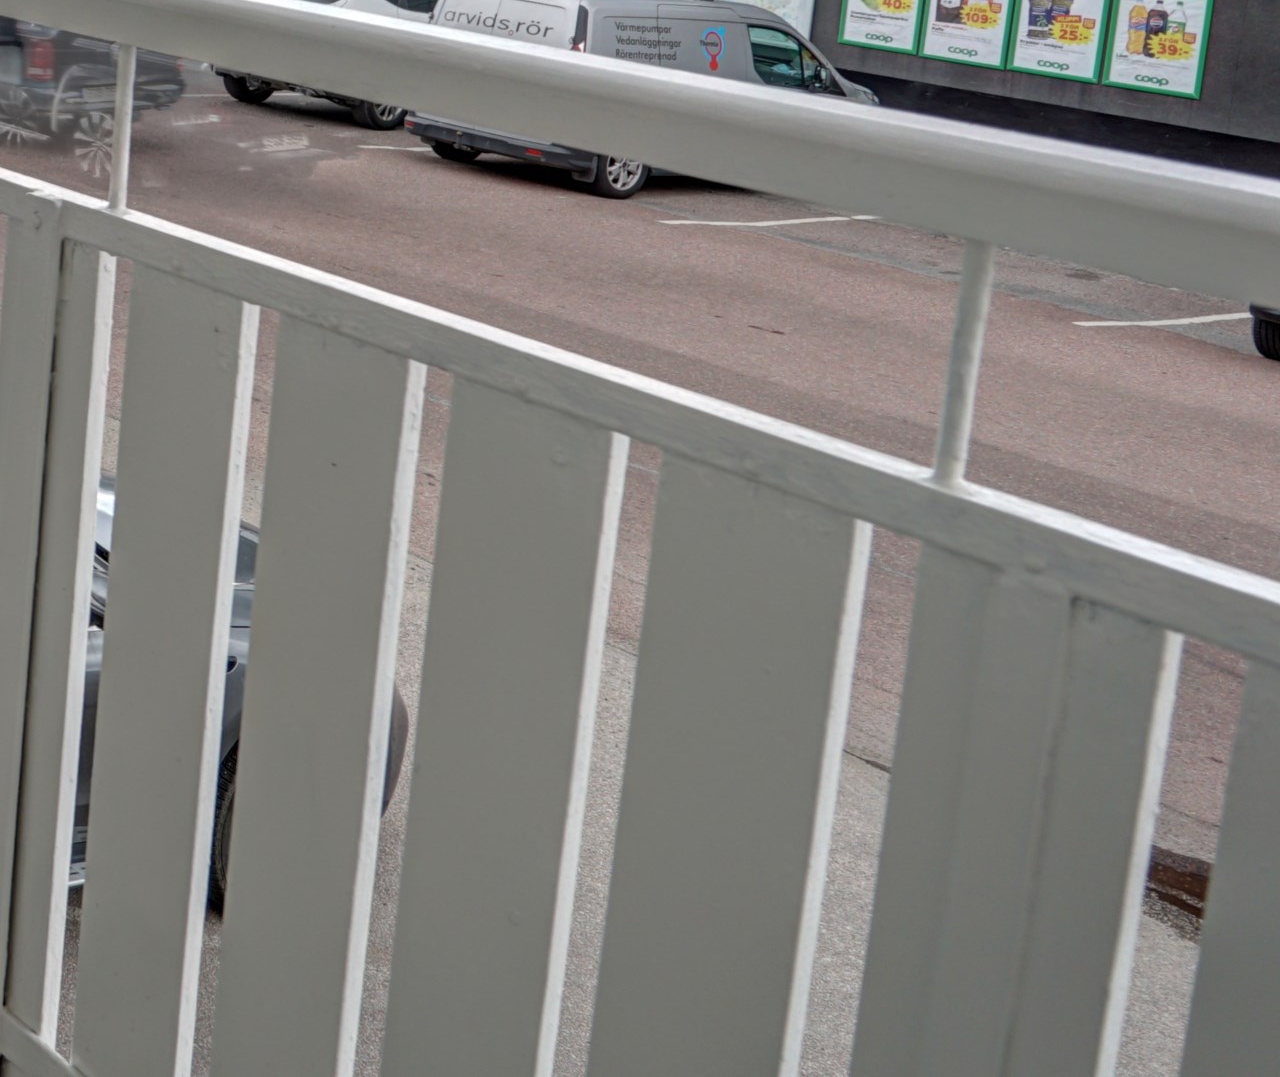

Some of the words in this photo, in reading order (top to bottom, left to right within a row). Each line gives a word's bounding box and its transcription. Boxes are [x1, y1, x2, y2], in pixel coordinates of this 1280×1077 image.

[965, 13, 997, 24] 109:-
[615, 21, 672, 35] Värmepumpar
[865, 33, 893, 43] coop
[1058, 29, 1088, 41] 25:-
[615, 35, 682, 50] Vedanläggningar
[947, 46, 978, 58] coop
[1157, 42, 1189, 56] 39:-
[615, 49, 677, 62] Rörentreprenad
[1037, 59, 1070, 71] coop
[1134, 74, 1169, 86] coop
